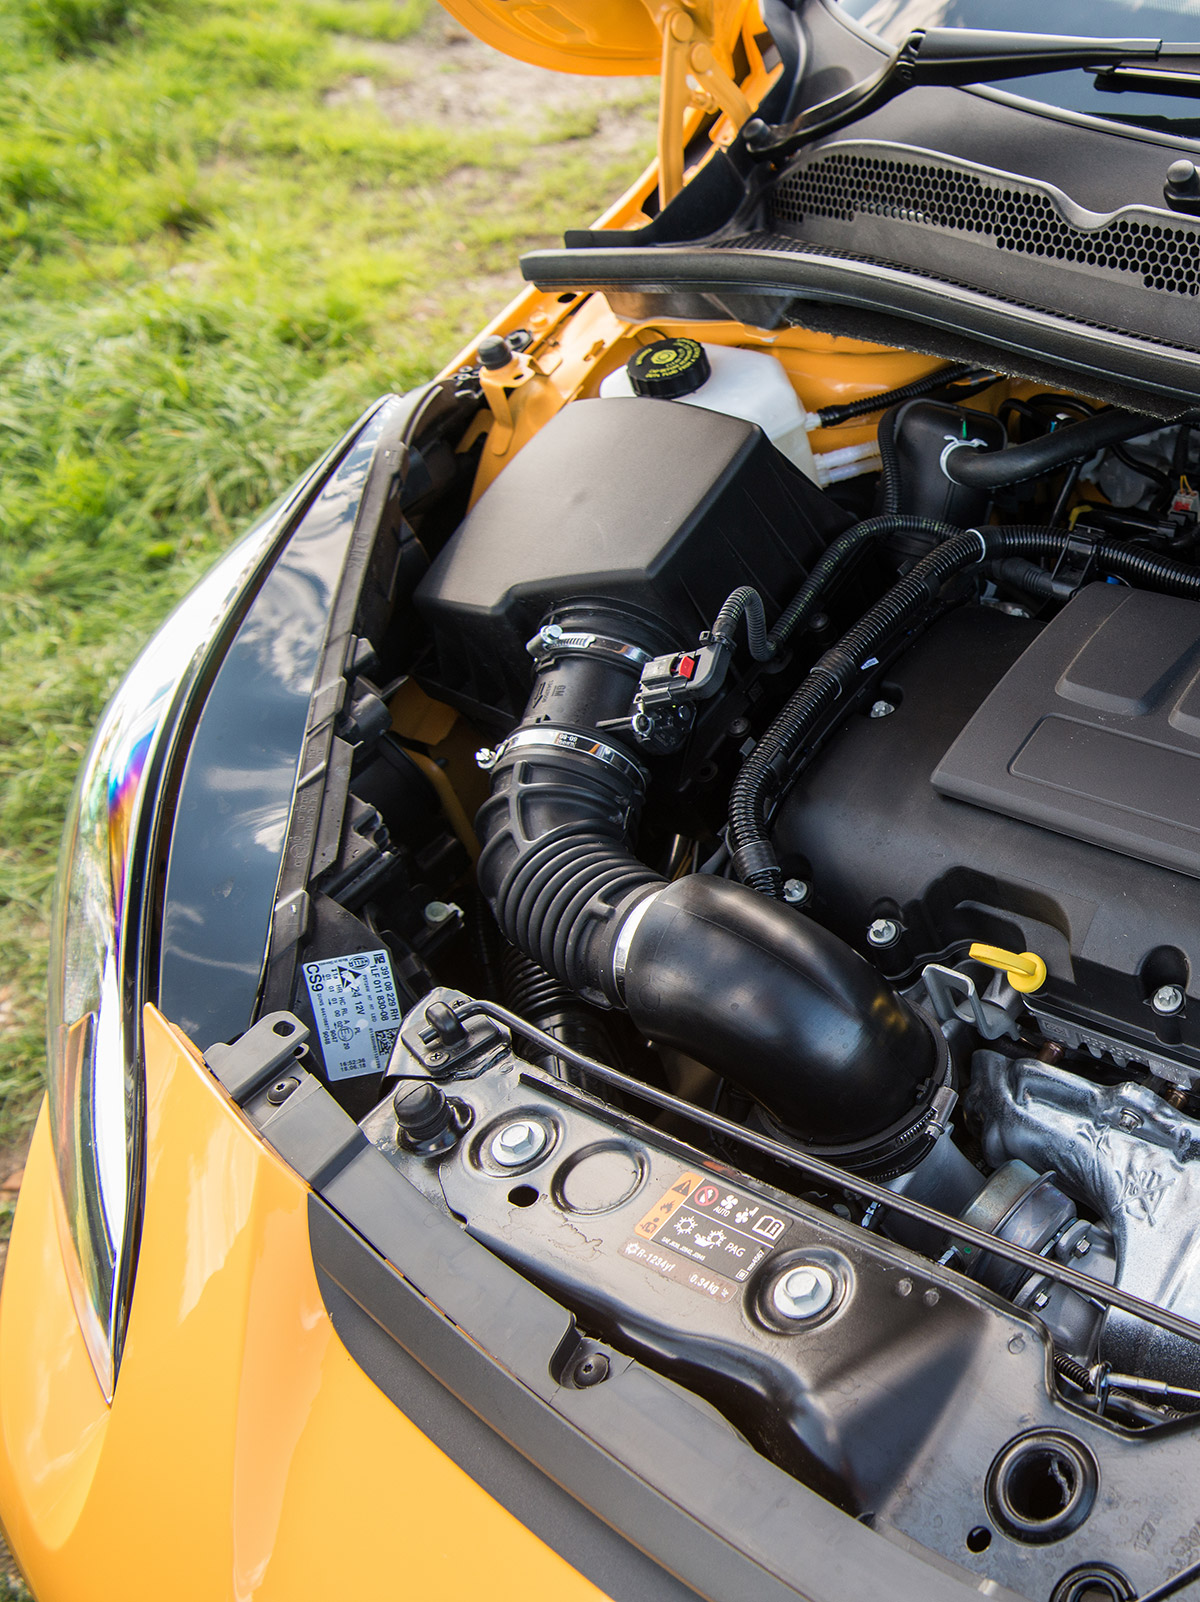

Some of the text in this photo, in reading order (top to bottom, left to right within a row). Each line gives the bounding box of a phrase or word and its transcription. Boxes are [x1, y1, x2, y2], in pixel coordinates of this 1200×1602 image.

[306, 964, 324, 992] CS9
[370, 964, 379, 978] 1LF
[380, 965, 389, 979] 391
[373, 979, 382, 993] 011
[387, 993, 396, 1007] 229
[355, 1001, 365, 1015] 12V
[390, 1008, 399, 1020] RH
[712, 1206, 731, 1217] AUTO
[724, 1242, 746, 1258] PAG
[636, 1248, 676, 1272] R-1234yf
